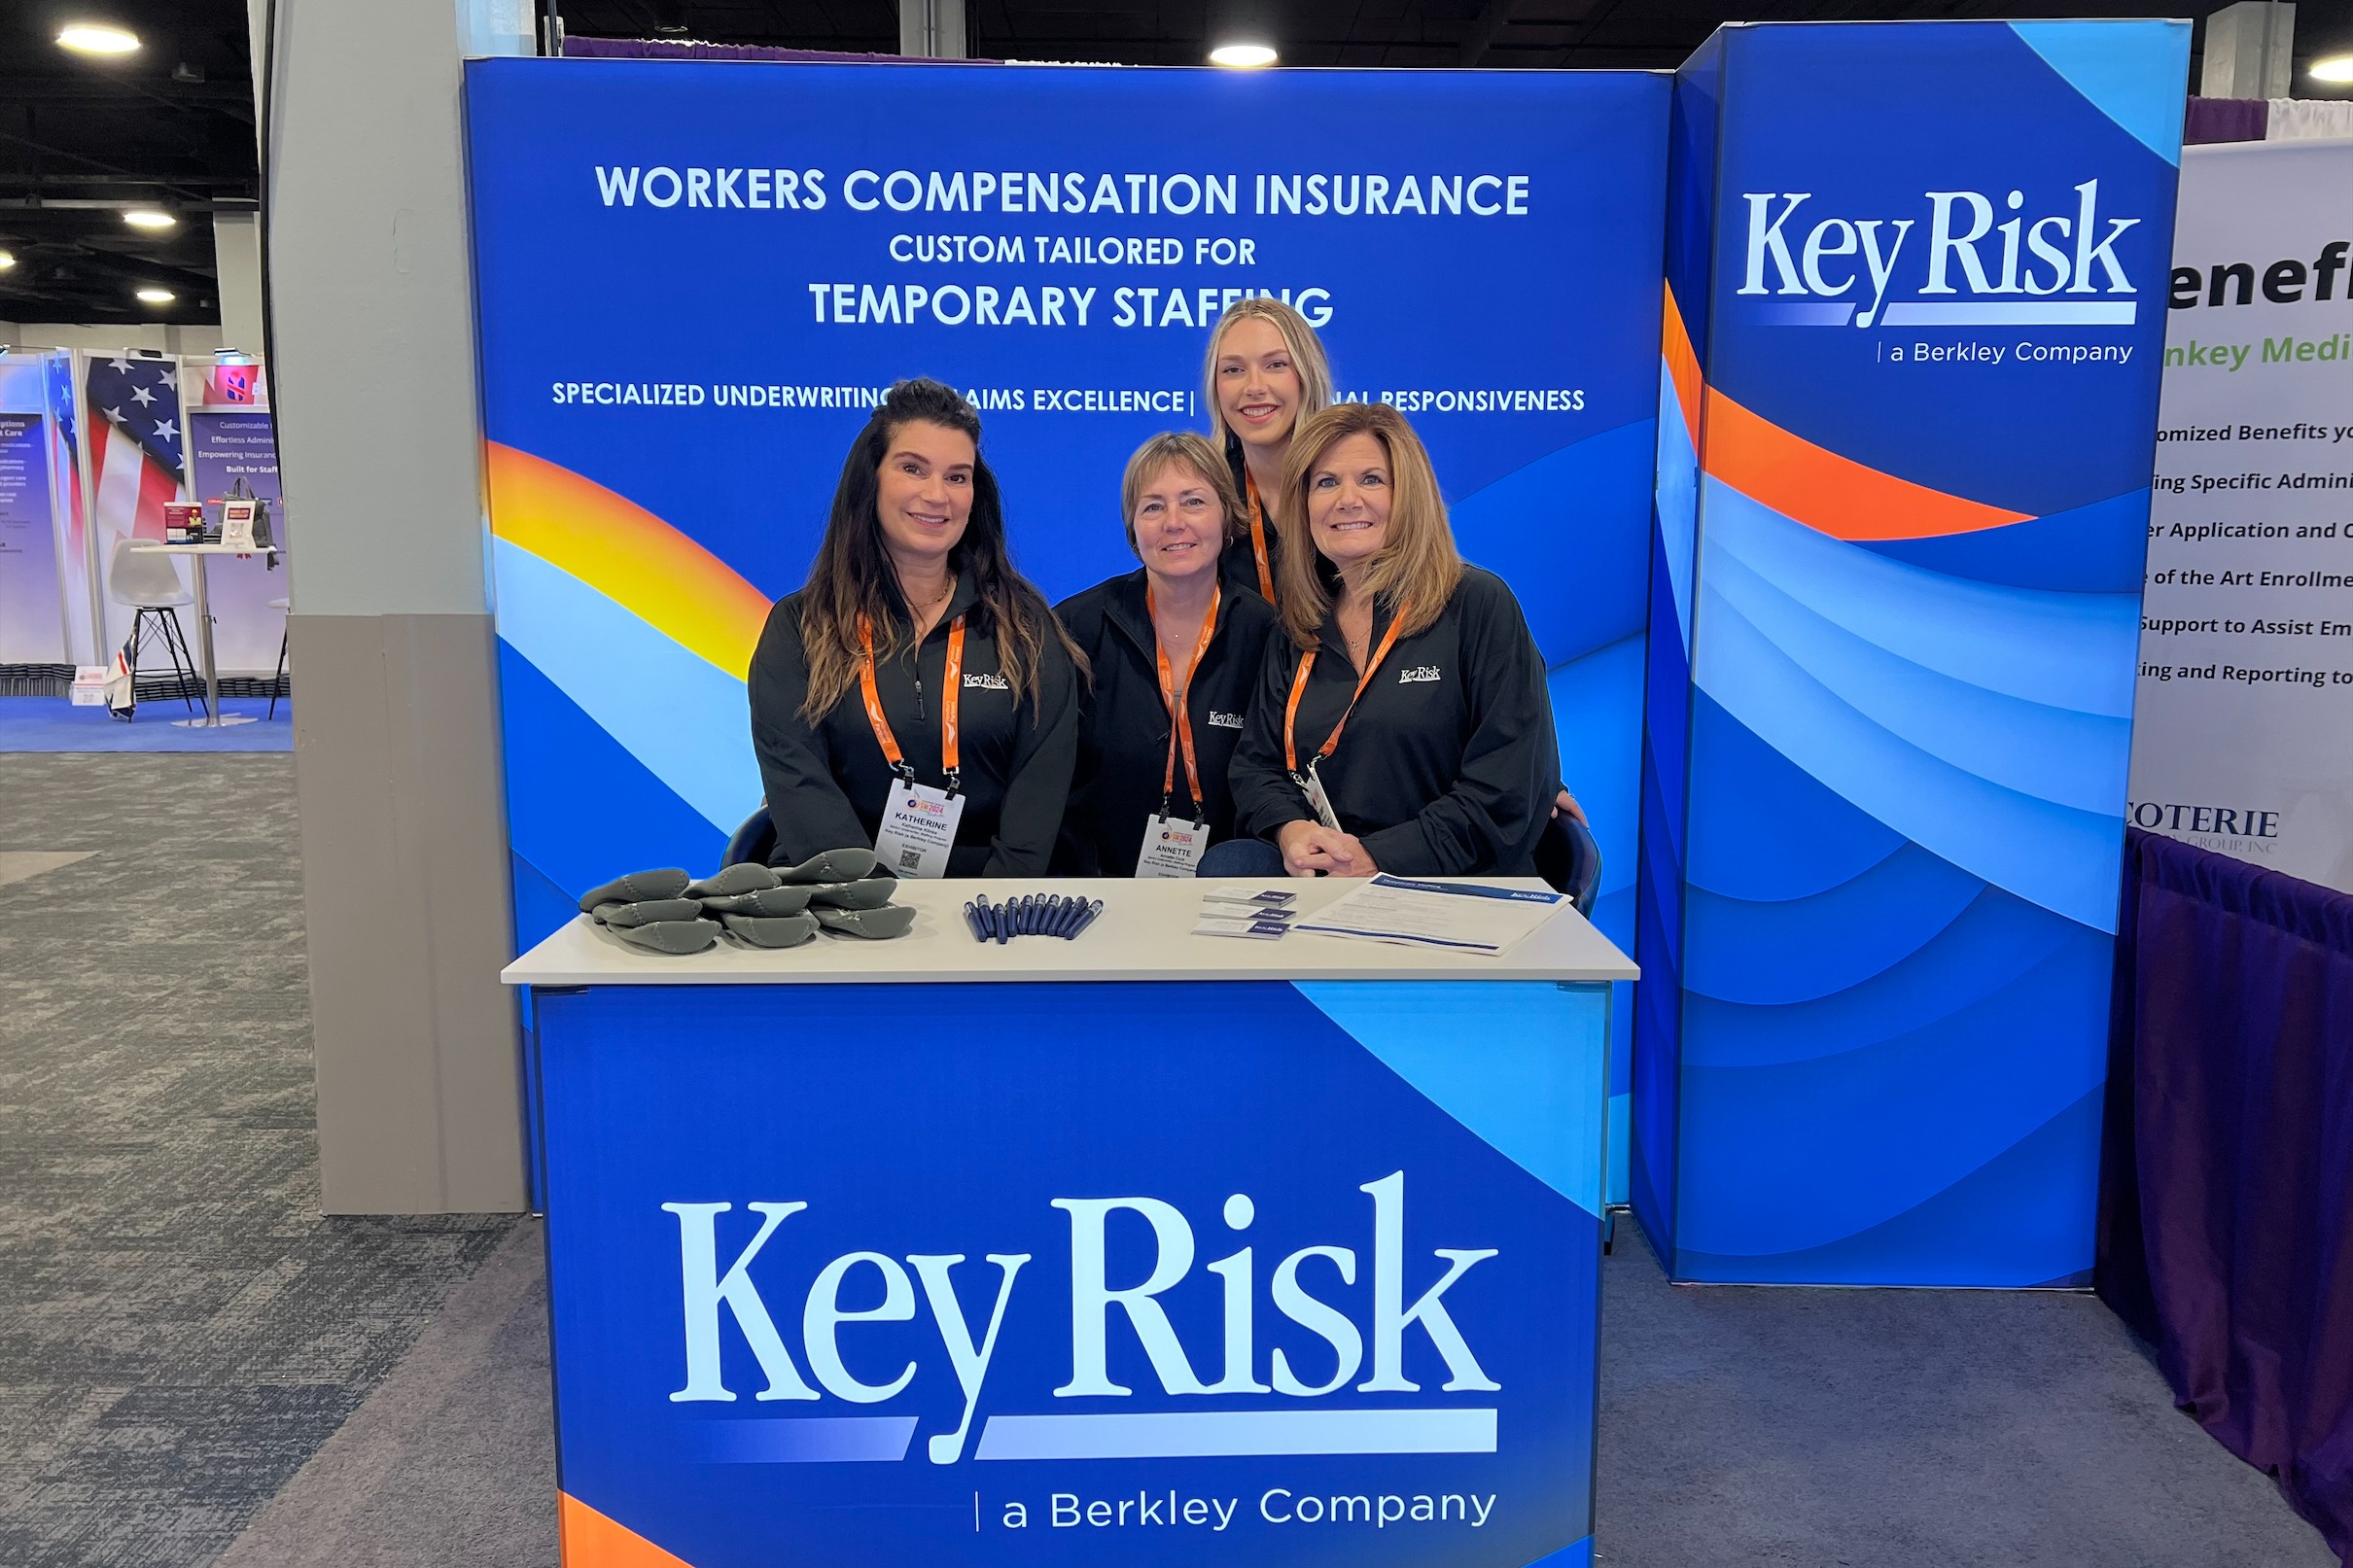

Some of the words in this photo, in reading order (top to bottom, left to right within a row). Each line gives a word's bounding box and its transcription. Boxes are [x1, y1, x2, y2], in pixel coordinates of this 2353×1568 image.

[595, 166, 826, 210] WORKERS
[843, 169, 1236, 215] COMPENSATION
[1255, 174, 1529, 216] INSURANCE
[889, 234, 1026, 263] CUSTOM
[1034, 236, 1184, 265] TAILORED
[1195, 237, 1256, 265] FOR
[1737, 192, 1915, 329] Key
[1917, 178, 2141, 296] Risk
[808, 283, 1097, 326] TEMPORARY
[1112, 287, 1334, 329] STAFFG
[1890, 347, 1904, 362] a
[1914, 341, 2006, 365] Berkley
[2015, 341, 2133, 365] Company
[2164, 341, 2251, 371] nkey
[2262, 333, 2351, 364] Medi
[552, 382, 705, 405] SPECIALIZED
[954, 389, 1026, 410] AIMS
[1381, 390, 1585, 412] RESPONSIVENESS
[220, 421, 269, 430] Customizable
[2238, 423, 2328, 440] Benefits
[211, 436, 245, 444] Effortless
[198, 451, 244, 460] Empowering
[2152, 474, 2186, 495] ing
[2191, 472, 2271, 494] Specific
[2169, 521, 2290, 542] Application
[2296, 522, 2336, 539] and
[2153, 569, 2175, 583] of
[2180, 569, 2214, 584] the
[2220, 570, 2254, 585] Art
[2260, 571, 2353, 588] Enrollme
[2141, 616, 2218, 636] Support
[2225, 619, 2246, 634] to
[2251, 619, 2313, 636] Assist
[2138, 662, 2172, 681] ing
[2177, 664, 2216, 680] and
[2222, 665, 2327, 688] Reporting
[2332, 670, 2353, 684] to
[896, 812, 948, 831] KATHERINE
[1156, 845, 1191, 856] ANNETTE
[660, 1201, 1032, 1464] Key
[1050, 1169, 1502, 1398] Risk
[1002, 1502, 1027, 1528] a
[1051, 1489, 1239, 1532] Berkley
[1260, 1488, 1497, 1528] Company
